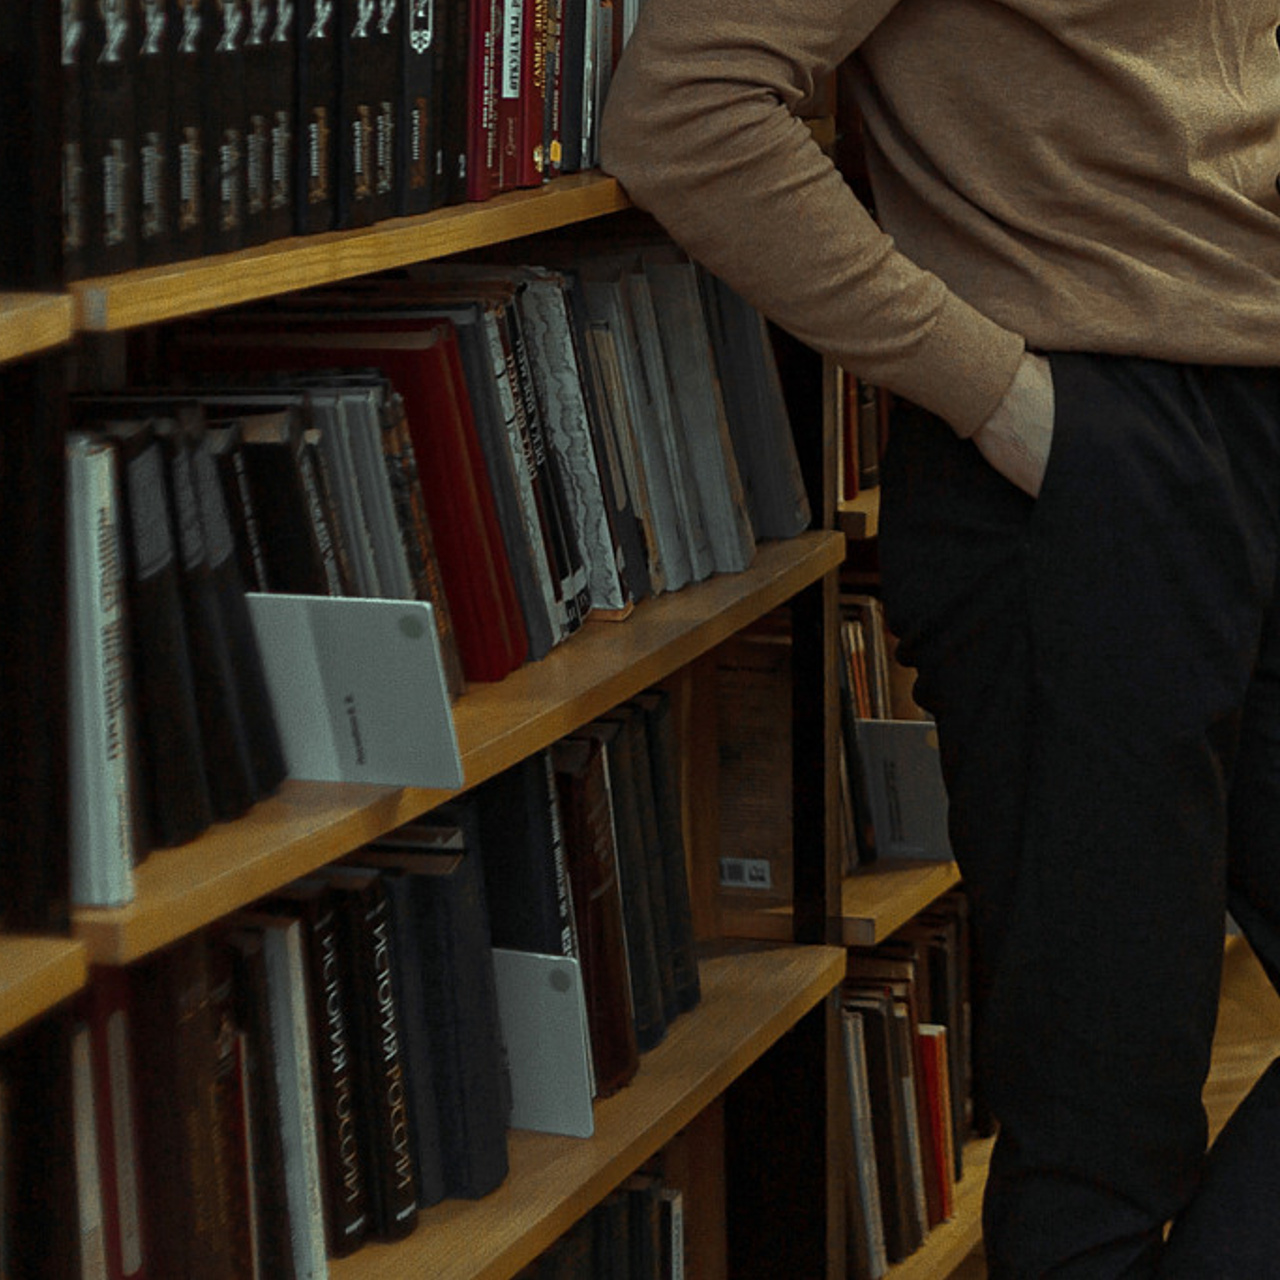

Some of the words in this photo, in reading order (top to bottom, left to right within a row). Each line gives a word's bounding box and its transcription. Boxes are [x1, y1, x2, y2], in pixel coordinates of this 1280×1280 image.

[533, 41, 542, 87] САМЫЕ
[320, 931, 348, 1073] ИСТОРИЯ
[334, 1075, 361, 1204] РОССИИ
[371, 920, 398, 1062] ИСТОРИЯ
[386, 1062, 412, 1191] РОССИИ
